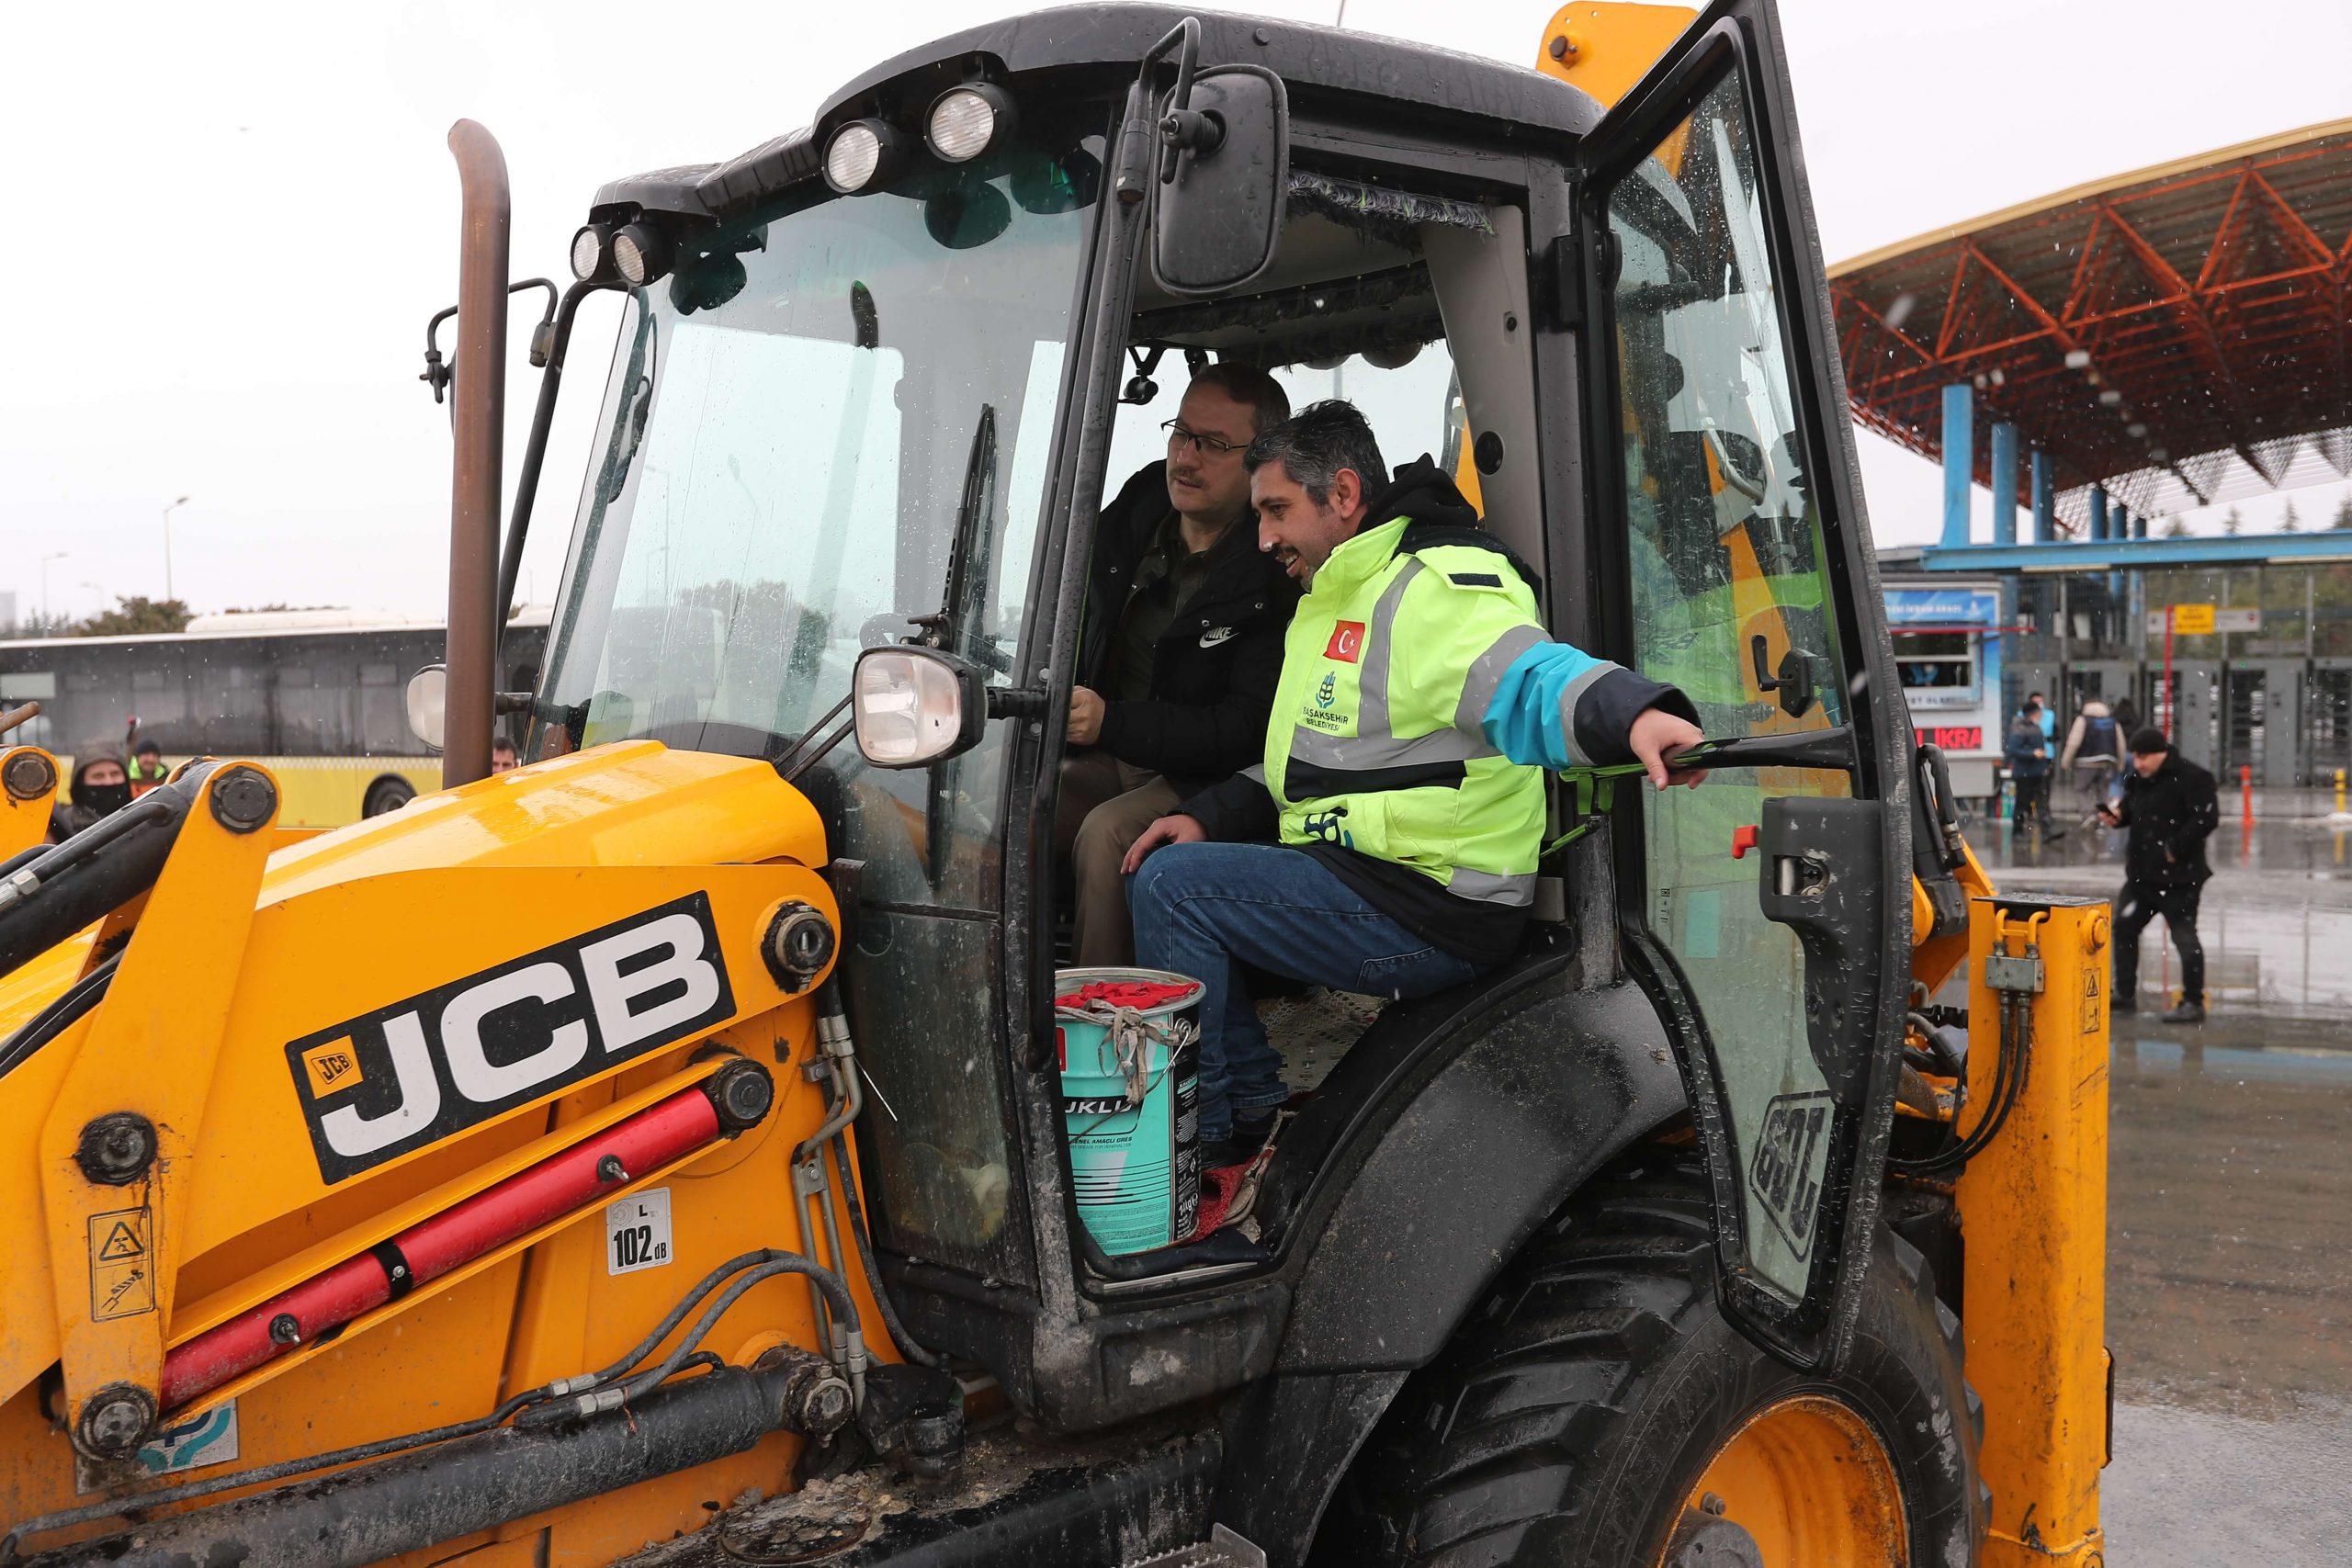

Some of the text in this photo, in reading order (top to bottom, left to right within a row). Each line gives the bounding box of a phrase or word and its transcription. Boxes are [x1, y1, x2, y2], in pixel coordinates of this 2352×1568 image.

[1204, 626, 1232, 639] NIKE
[321, 913, 719, 1157] JCB
[318, 1055, 350, 1080] JCB
[613, 1224, 667, 1268] 102 dB
